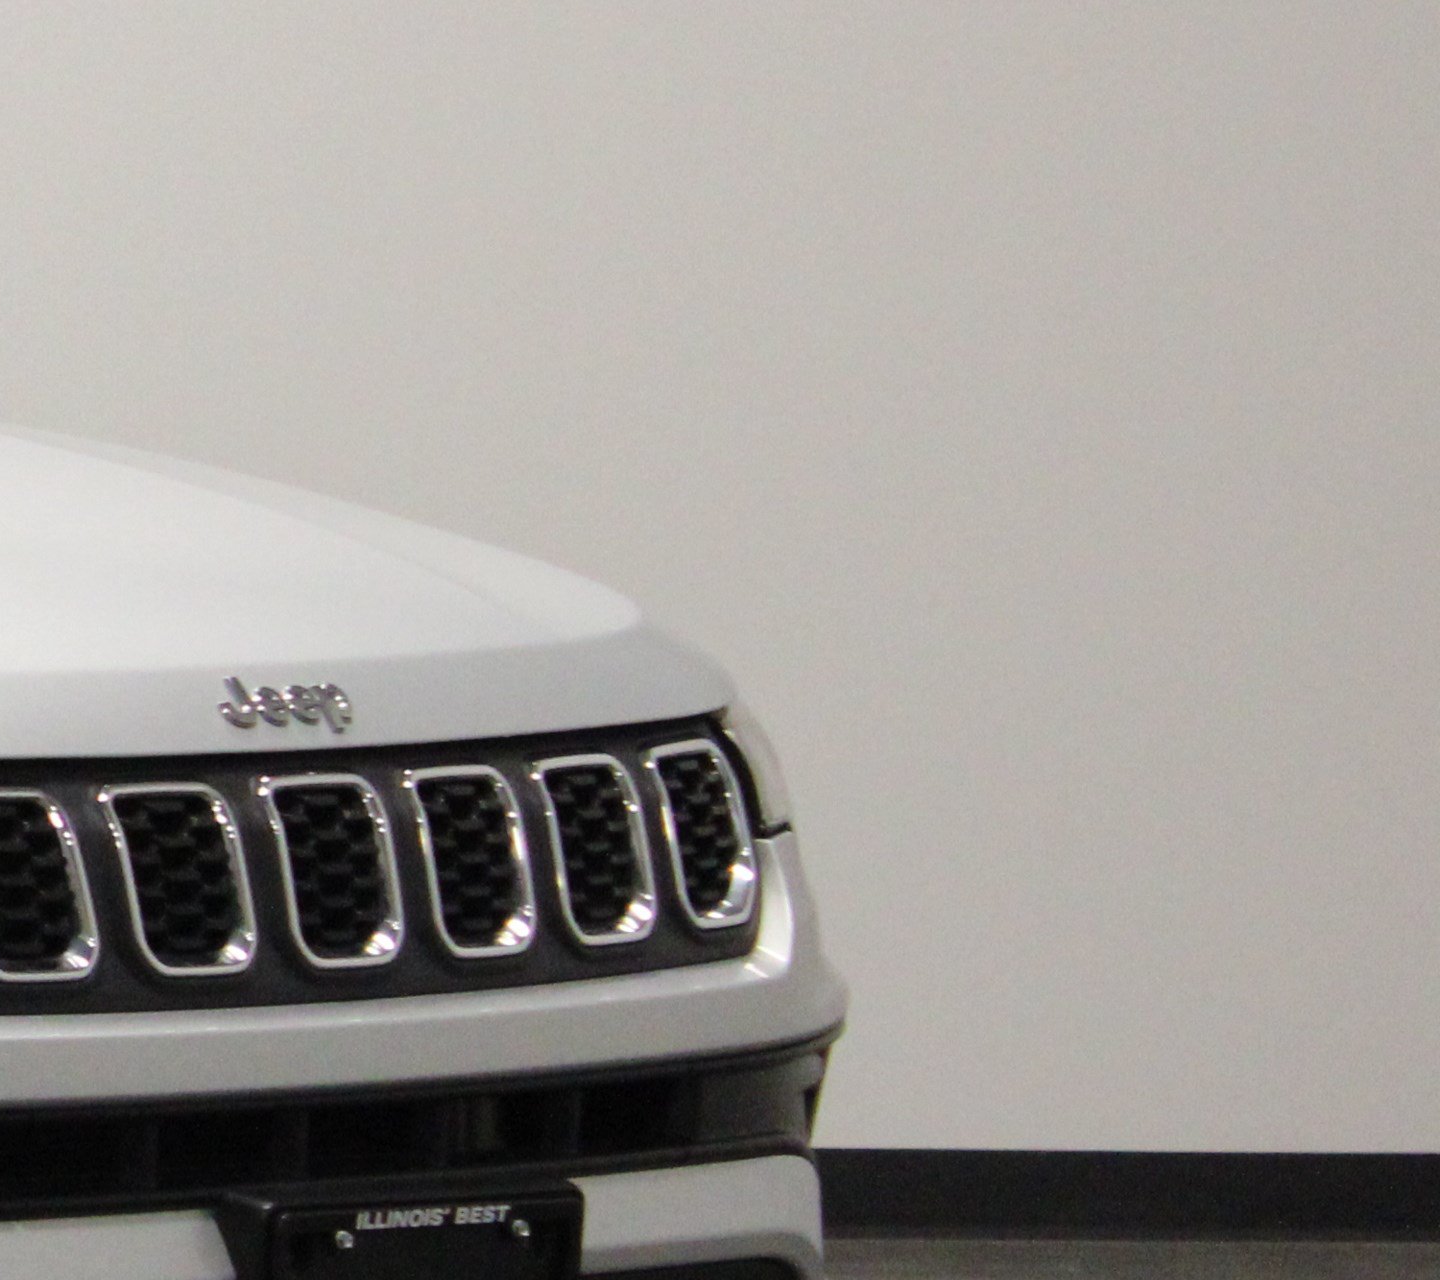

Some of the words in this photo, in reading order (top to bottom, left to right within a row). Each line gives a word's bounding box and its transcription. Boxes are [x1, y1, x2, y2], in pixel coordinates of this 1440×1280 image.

[217, 676, 353, 735] Jeep
[355, 1205, 453, 1231] ILLINOIS'
[454, 1204, 512, 1225] BEST
